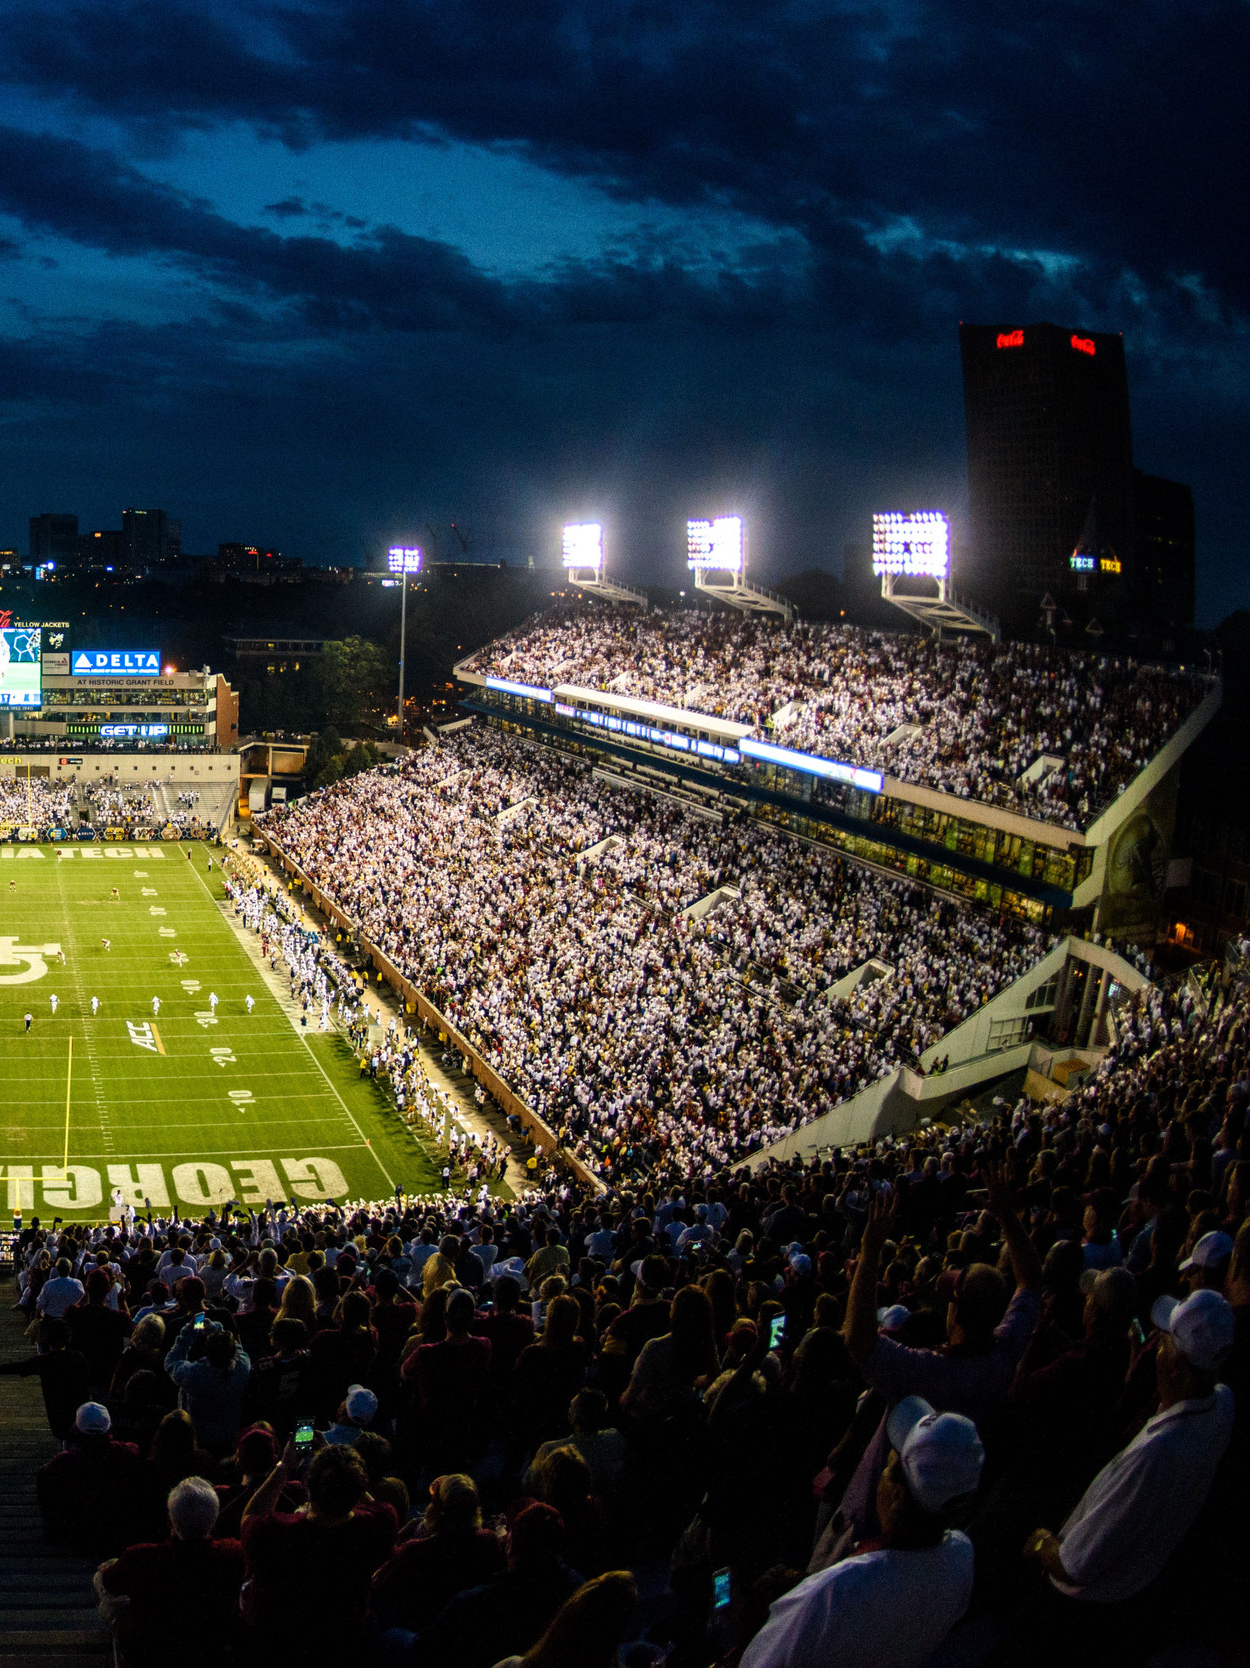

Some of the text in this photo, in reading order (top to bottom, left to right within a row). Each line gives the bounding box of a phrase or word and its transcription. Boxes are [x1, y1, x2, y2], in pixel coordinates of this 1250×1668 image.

[1070, 558, 1094, 568] TECH
[1100, 559, 1121, 574] TECH
[96, 654, 158, 667] DELTA
[100, 725, 166, 736] GET UP
[54, 848, 165, 858] TECH
[180, 980, 202, 991] 40
[194, 1011, 218, 1024] 30
[126, 1020, 157, 1052] ACC
[210, 1048, 237, 1063] 20
[228, 1090, 256, 1106] 10
